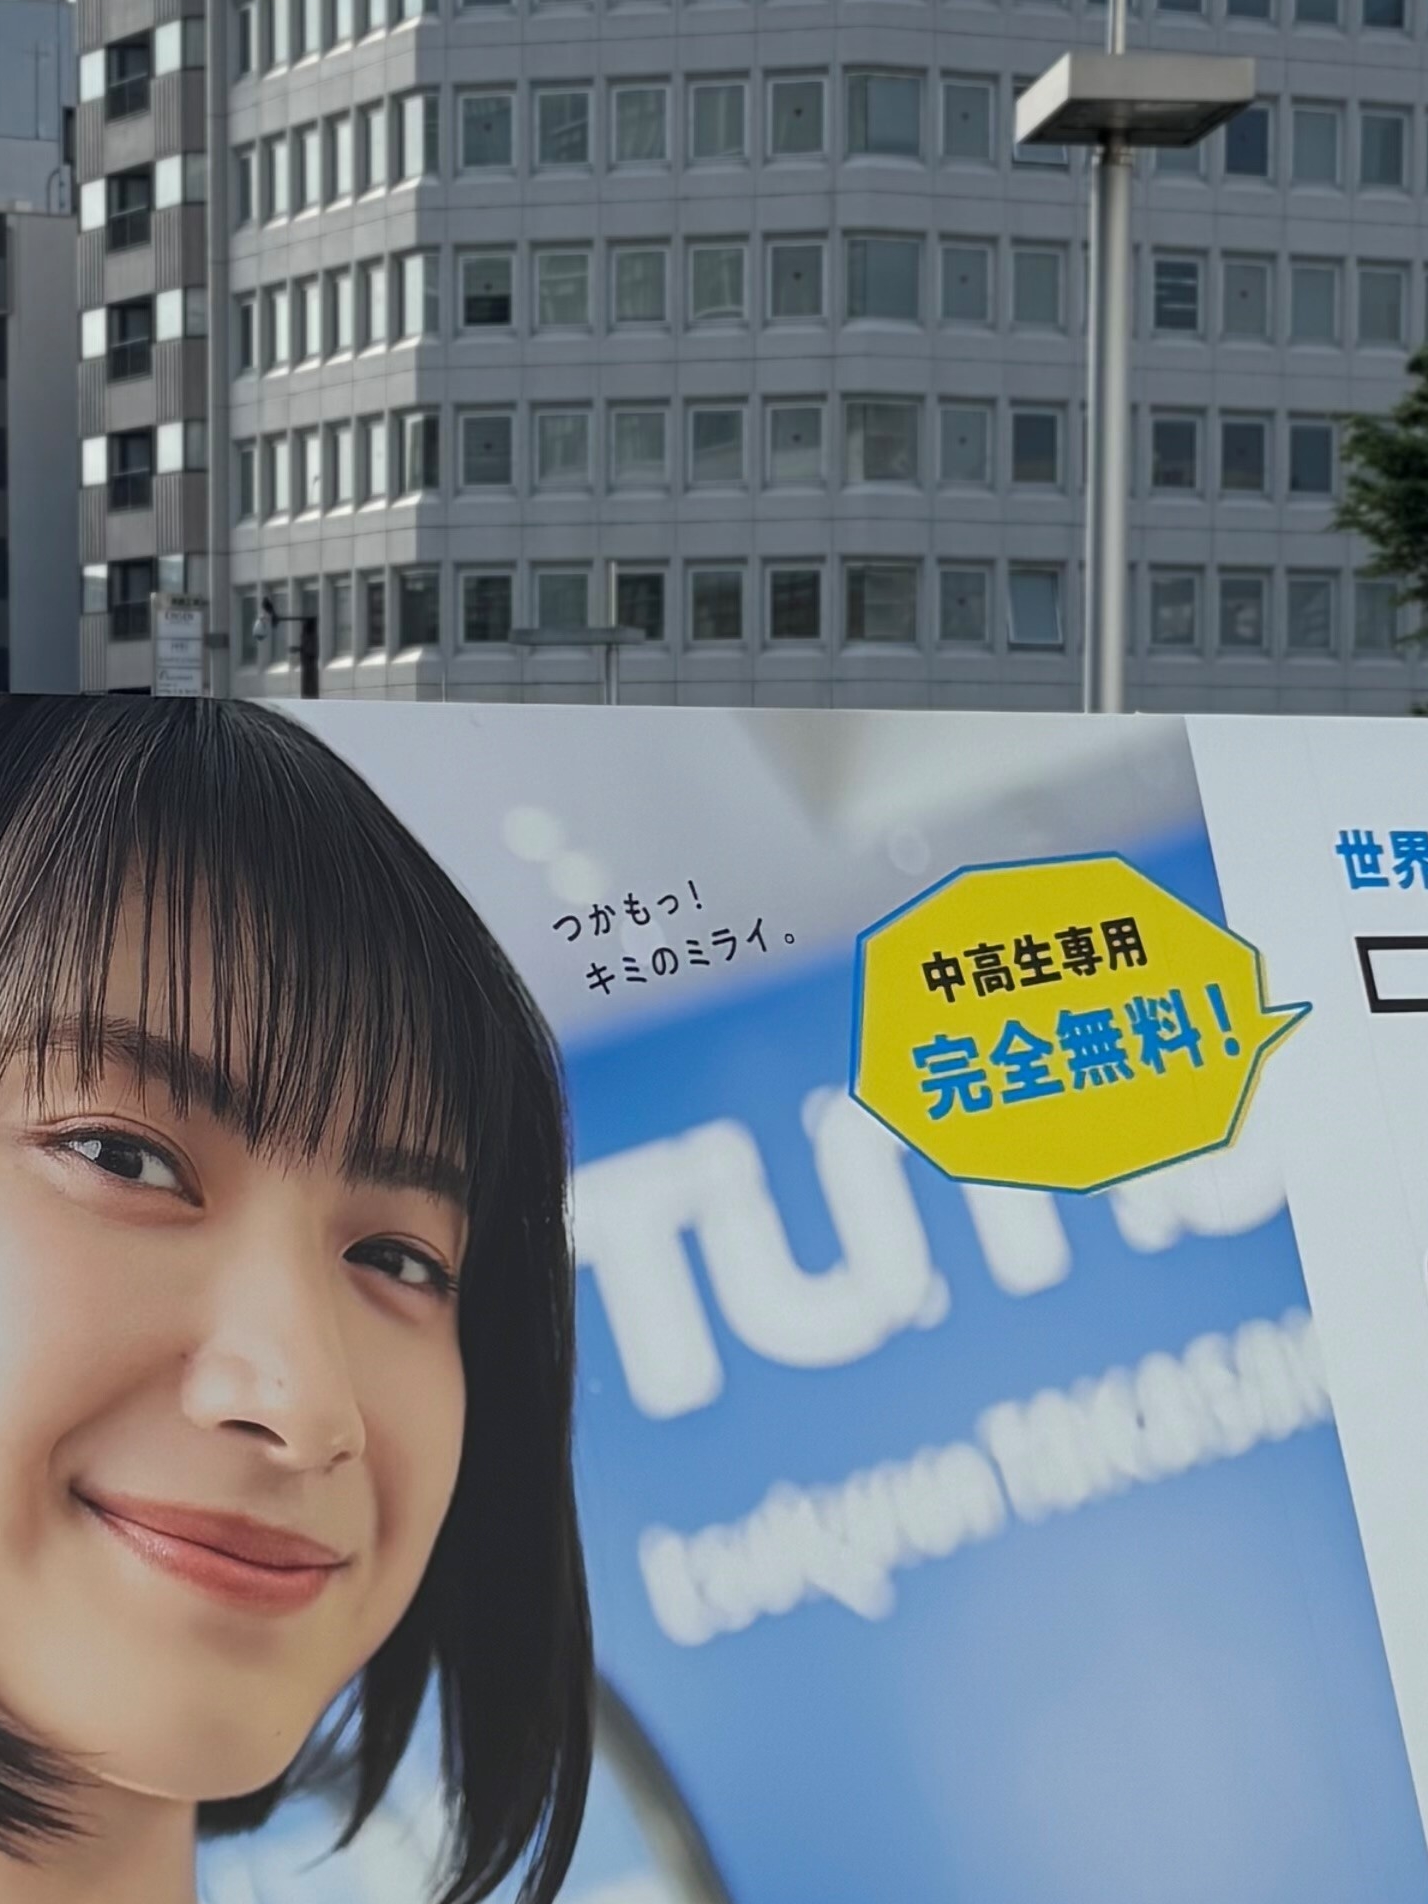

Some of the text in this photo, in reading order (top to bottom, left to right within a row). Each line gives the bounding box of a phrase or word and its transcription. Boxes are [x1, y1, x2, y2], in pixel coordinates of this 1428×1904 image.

[585, 917, 796, 996] キミのミライ。
[922, 916, 1149, 1004] 中高生専用
[912, 983, 1241, 1120] 完全無料！
